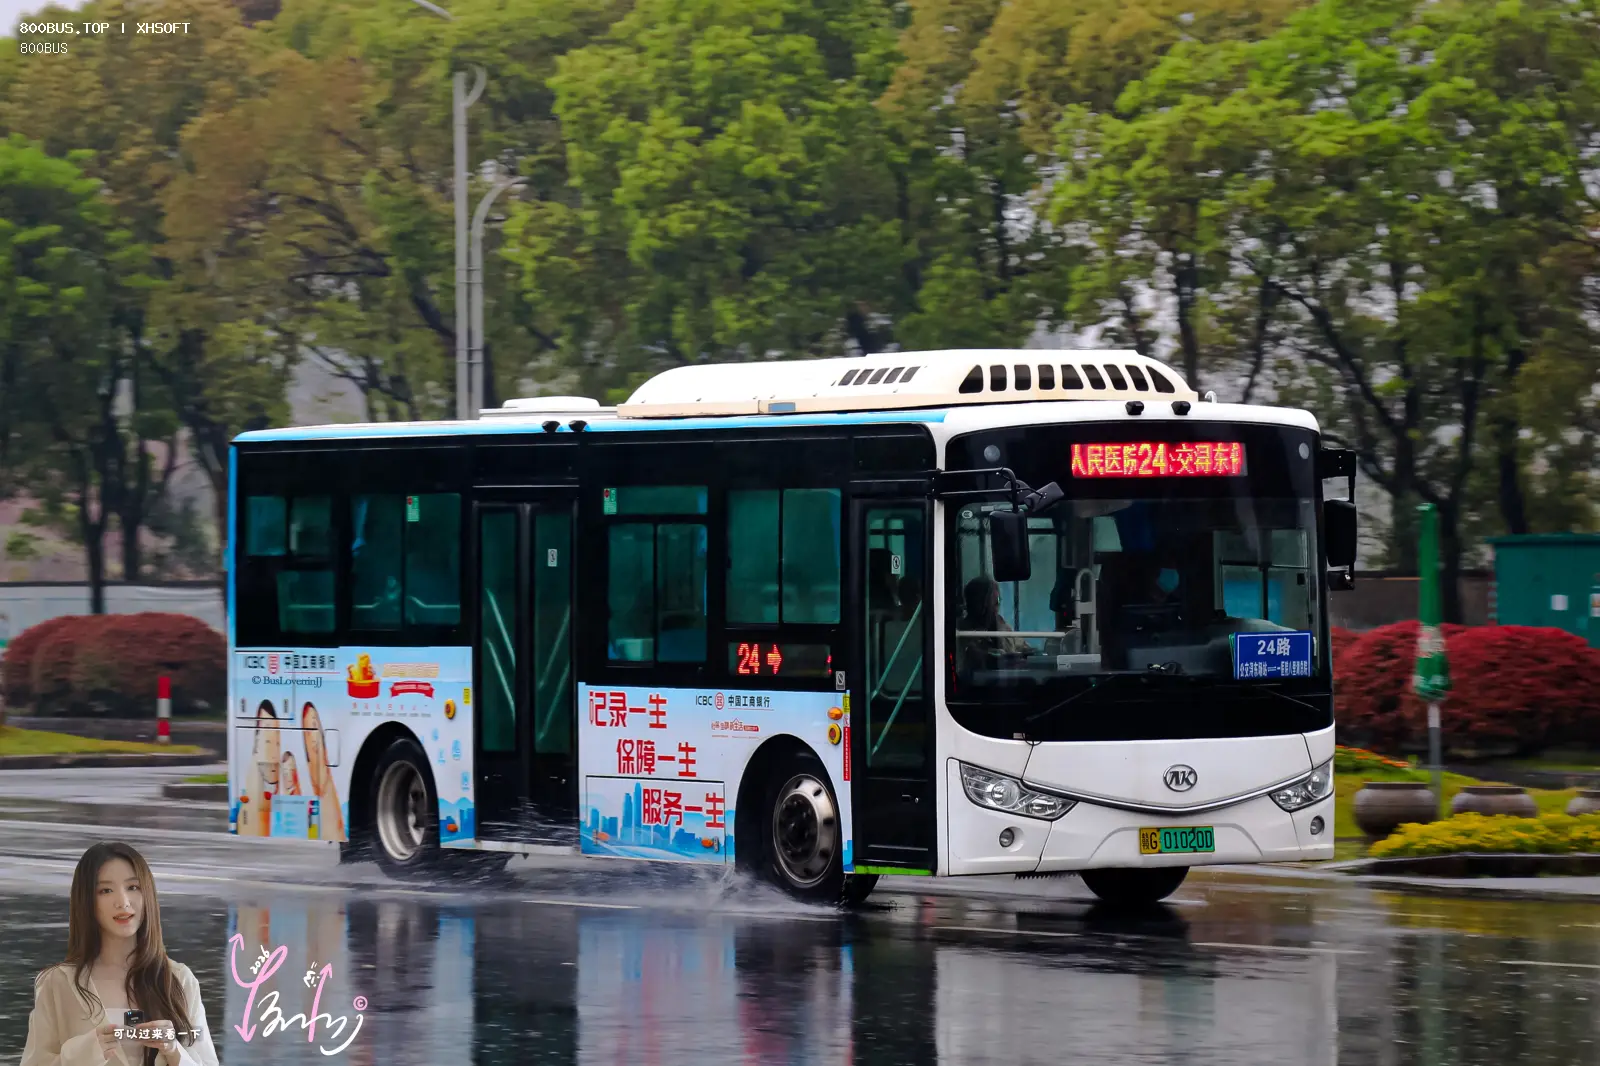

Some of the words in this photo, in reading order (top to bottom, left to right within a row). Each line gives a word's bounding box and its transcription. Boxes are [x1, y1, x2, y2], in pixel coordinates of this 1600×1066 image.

[1071, 443, 1137, 475] 人民医院
[1138, 443, 1166, 475] 24
[737, 643, 760, 674] 24
[1257, 637, 1291, 656] 24路
[588, 690, 667, 729] 记录一生
[695, 695, 713, 706] ICBC
[728, 695, 771, 708] 中国工商银行
[616, 738, 697, 777] 保障一生
[642, 788, 725, 828] 服务一生
